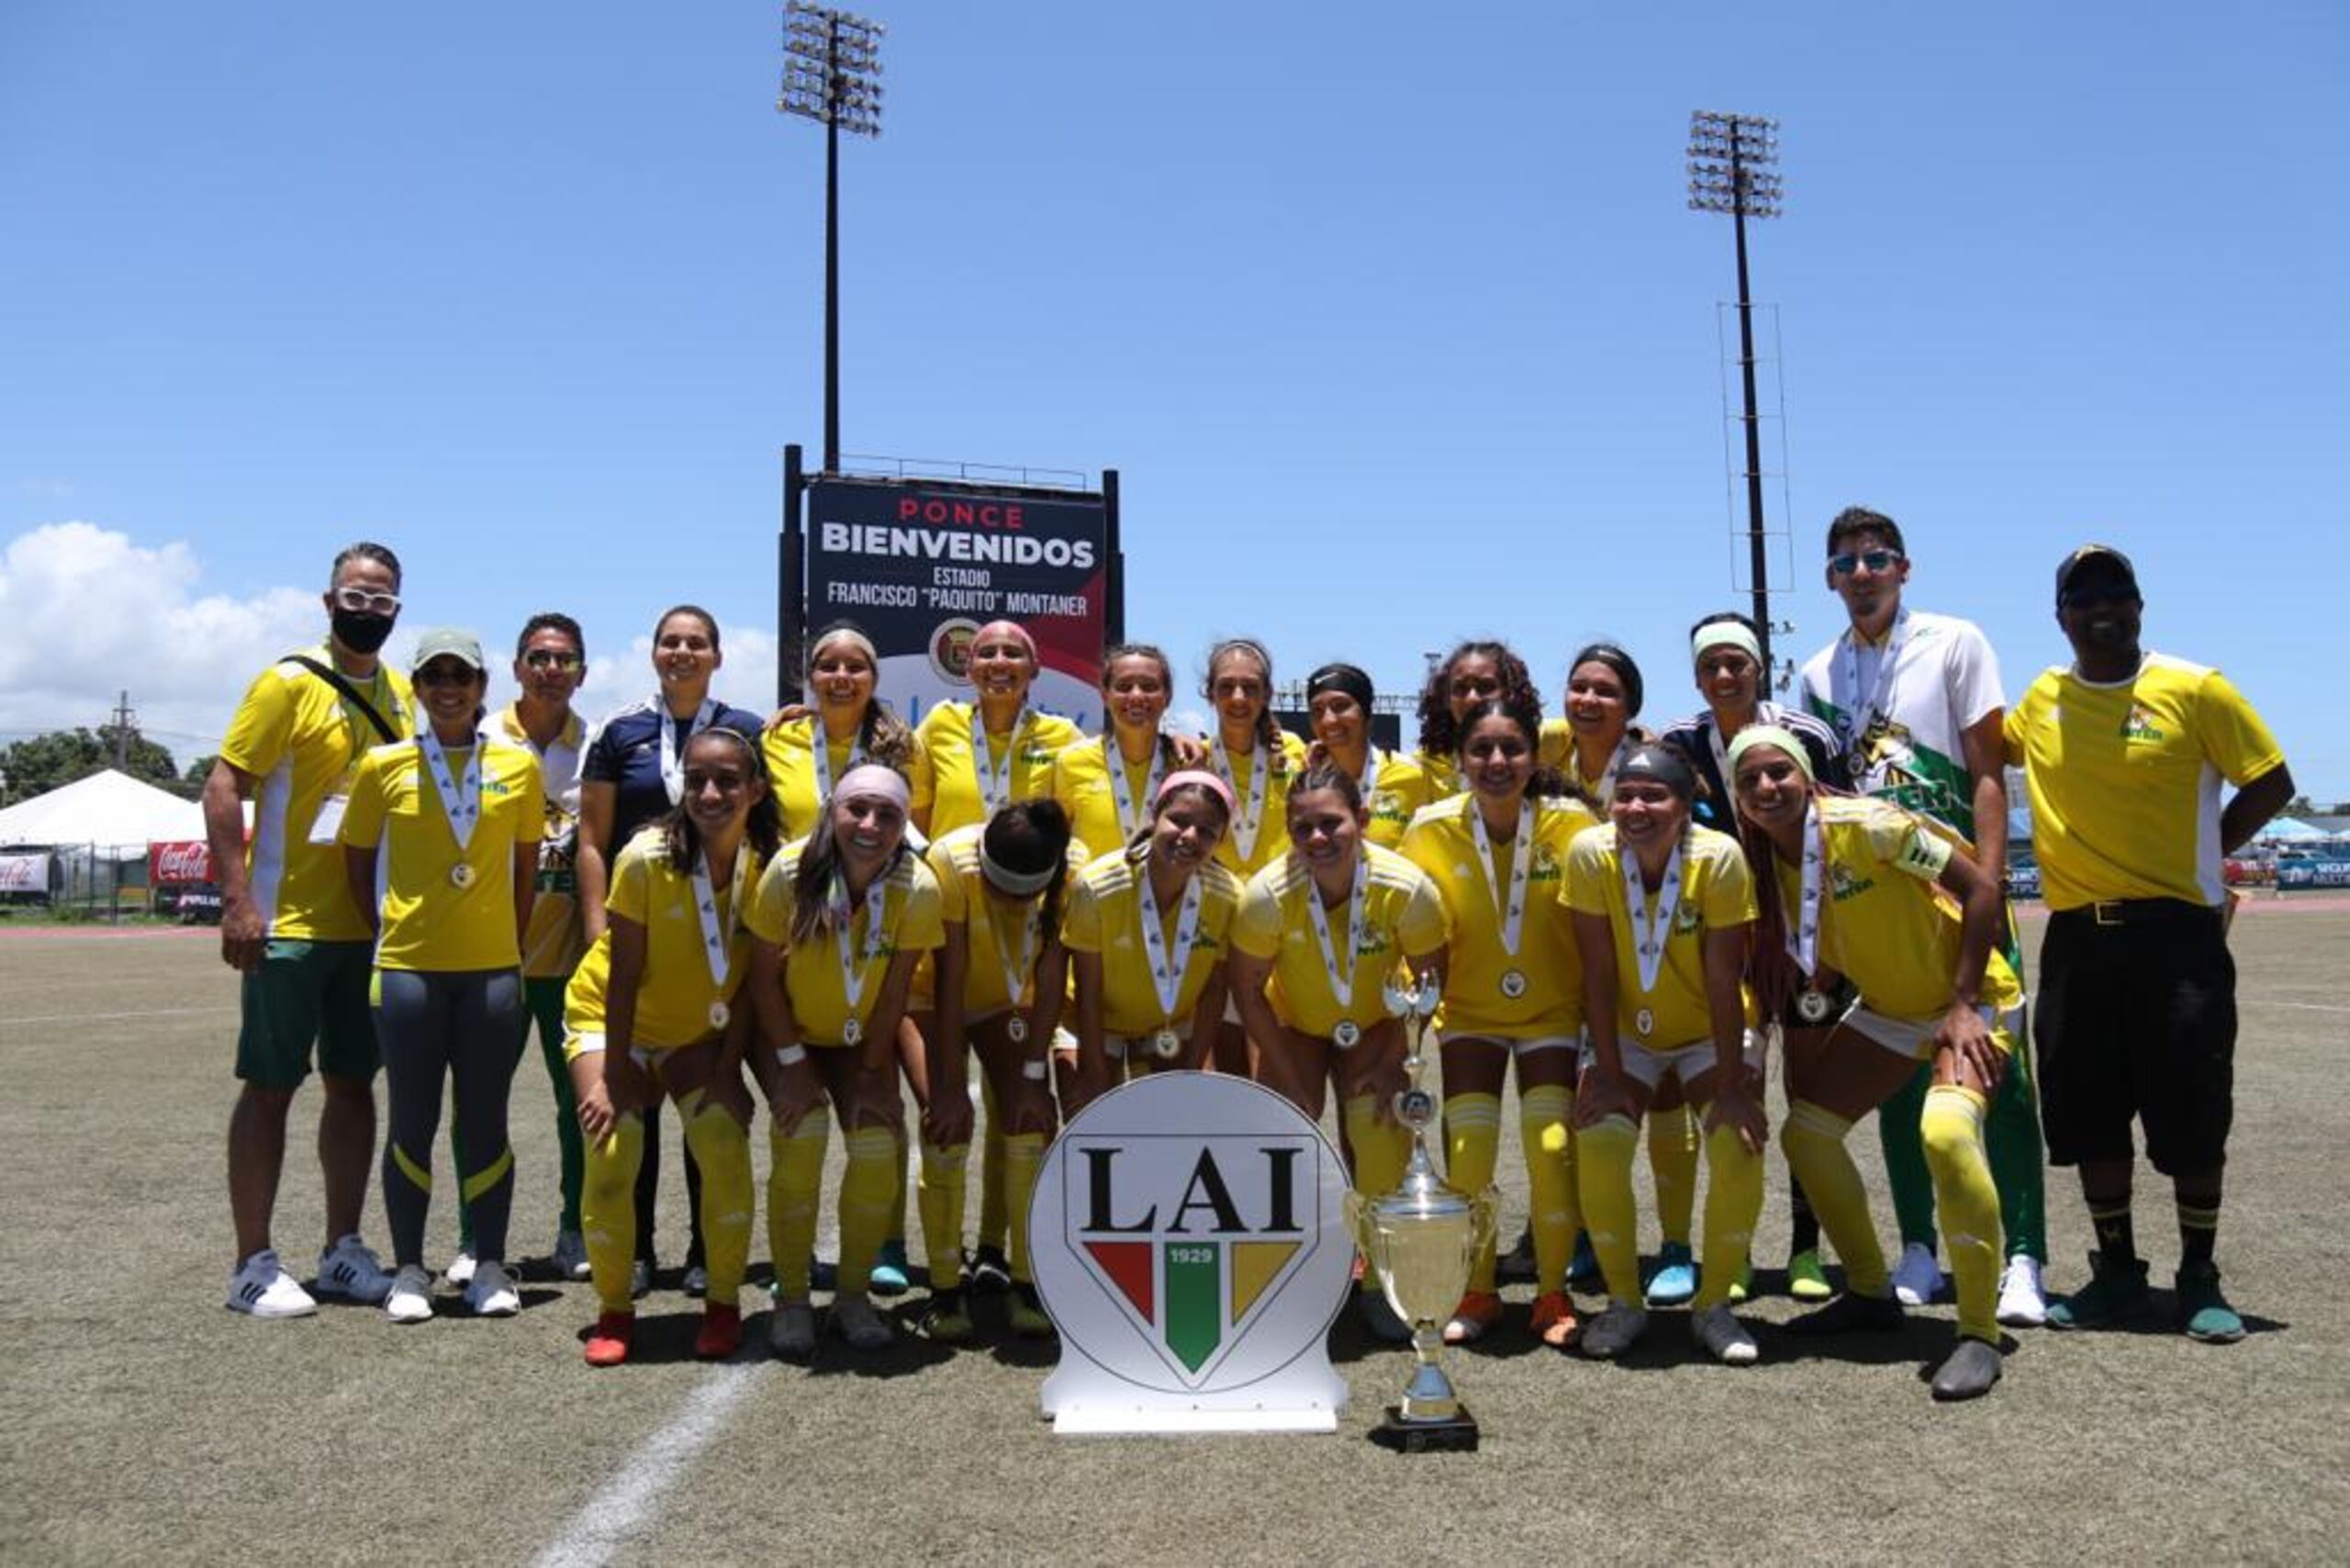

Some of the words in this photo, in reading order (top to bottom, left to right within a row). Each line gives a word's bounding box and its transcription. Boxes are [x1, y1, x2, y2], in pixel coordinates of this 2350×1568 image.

[900, 498, 1024, 530] PONCE
[822, 521, 1095, 569] BIENVENIDOS
[933, 566, 990, 588] ESTADIO
[827, 581, 917, 608] FRANCISCO
[1006, 591, 1087, 617] MONTANER
[1079, 1146, 1304, 1234] LAI
[1169, 1248, 1213, 1264] 1929
